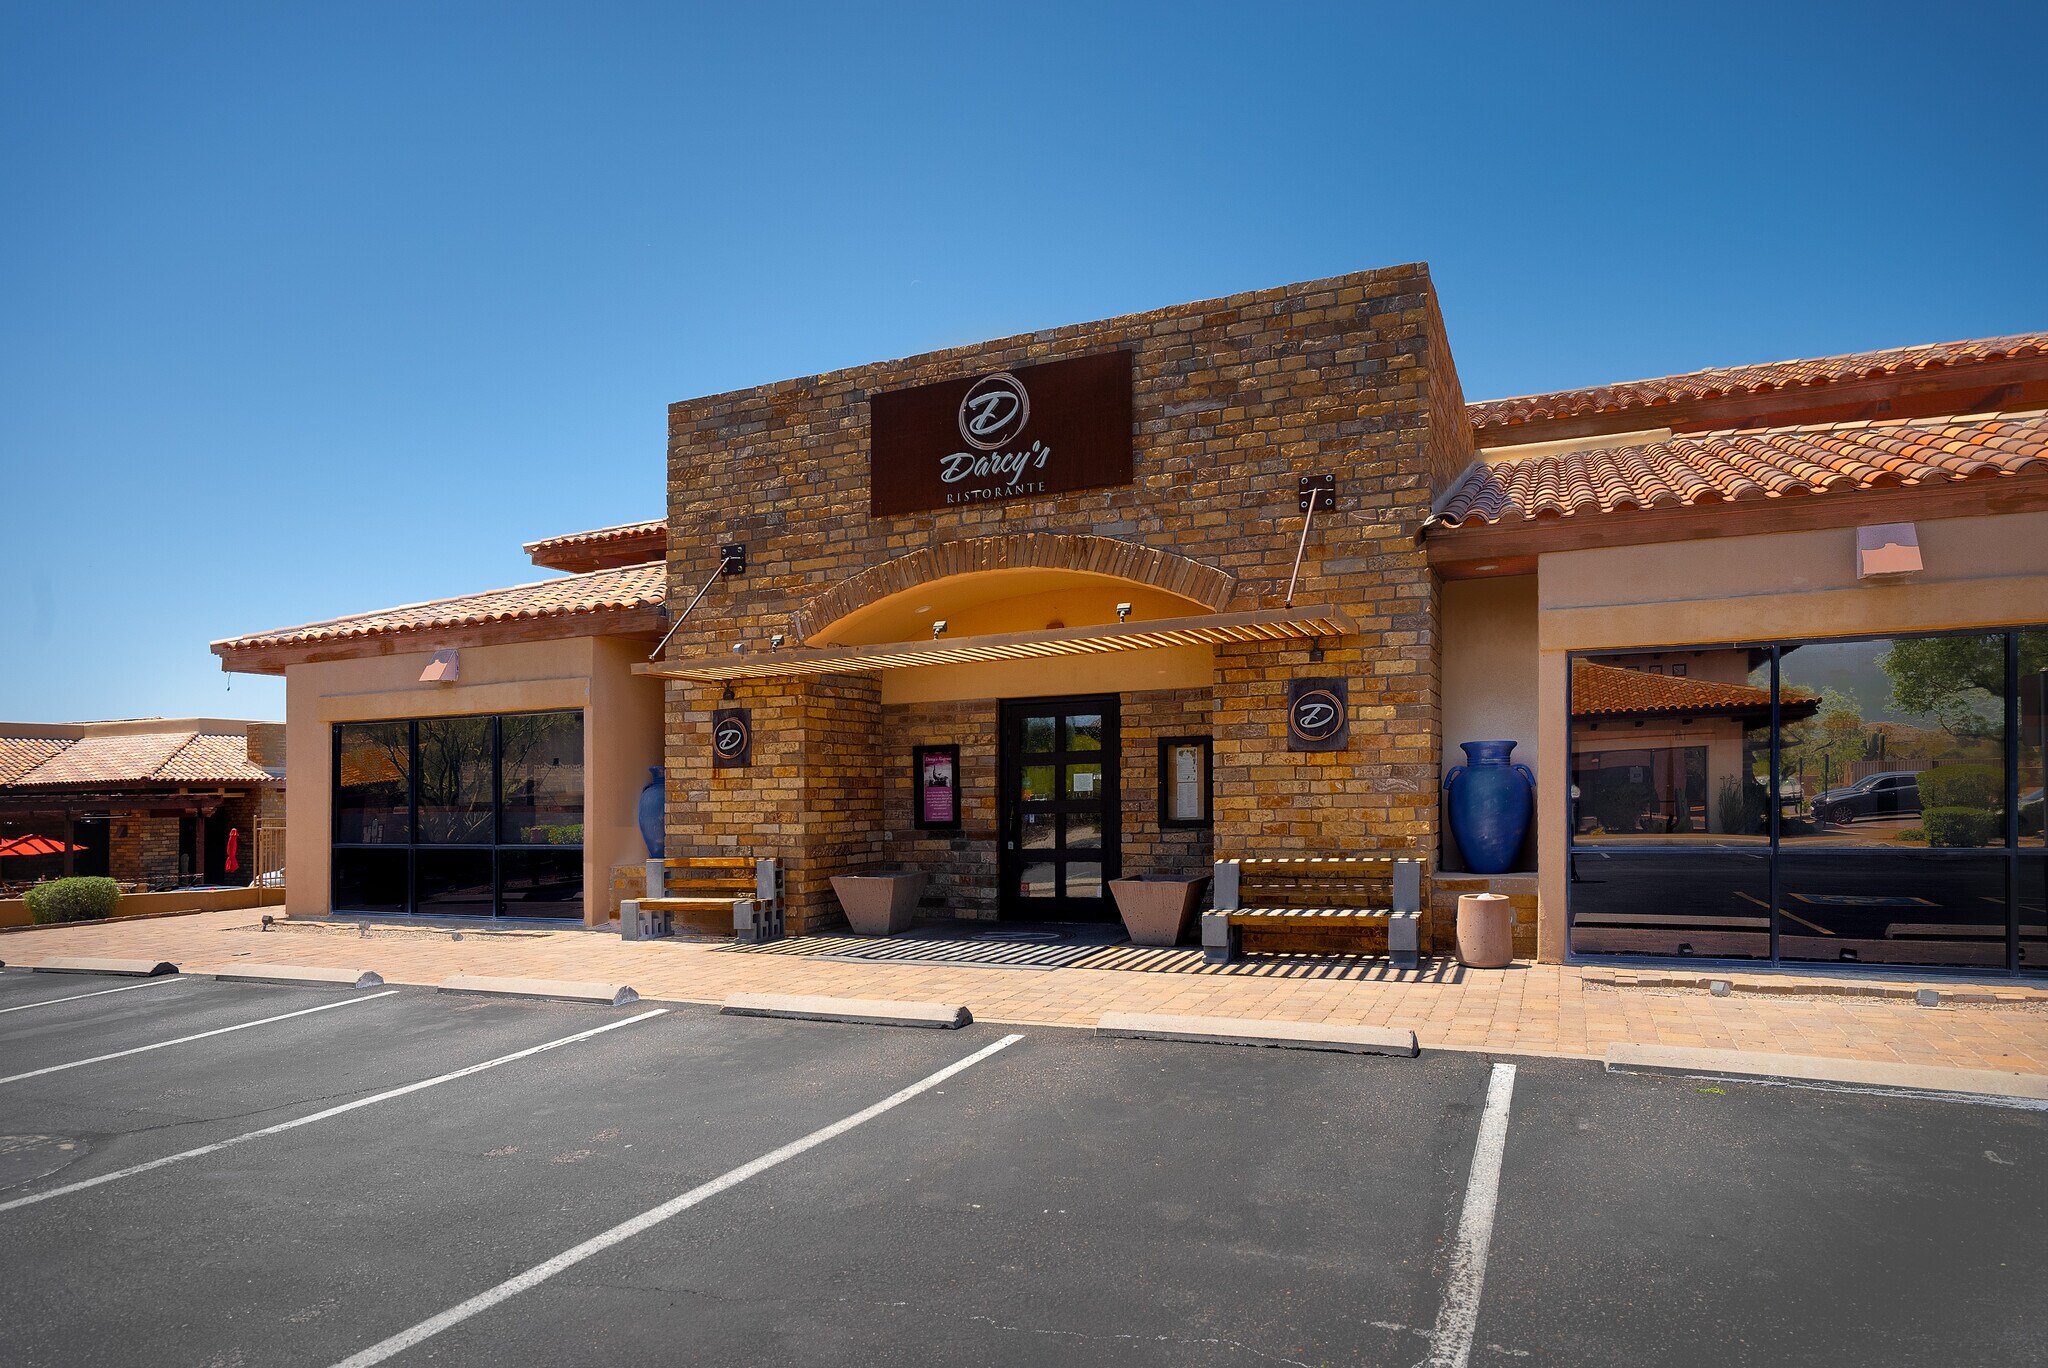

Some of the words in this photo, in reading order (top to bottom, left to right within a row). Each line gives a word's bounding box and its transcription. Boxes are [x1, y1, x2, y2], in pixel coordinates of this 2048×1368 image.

[969, 391, 1019, 435] D
[940, 440, 1050, 486] Darcy's
[947, 481, 1046, 504] RISTORANTE
[1300, 703, 1334, 729] D
[719, 729, 741, 750] D
